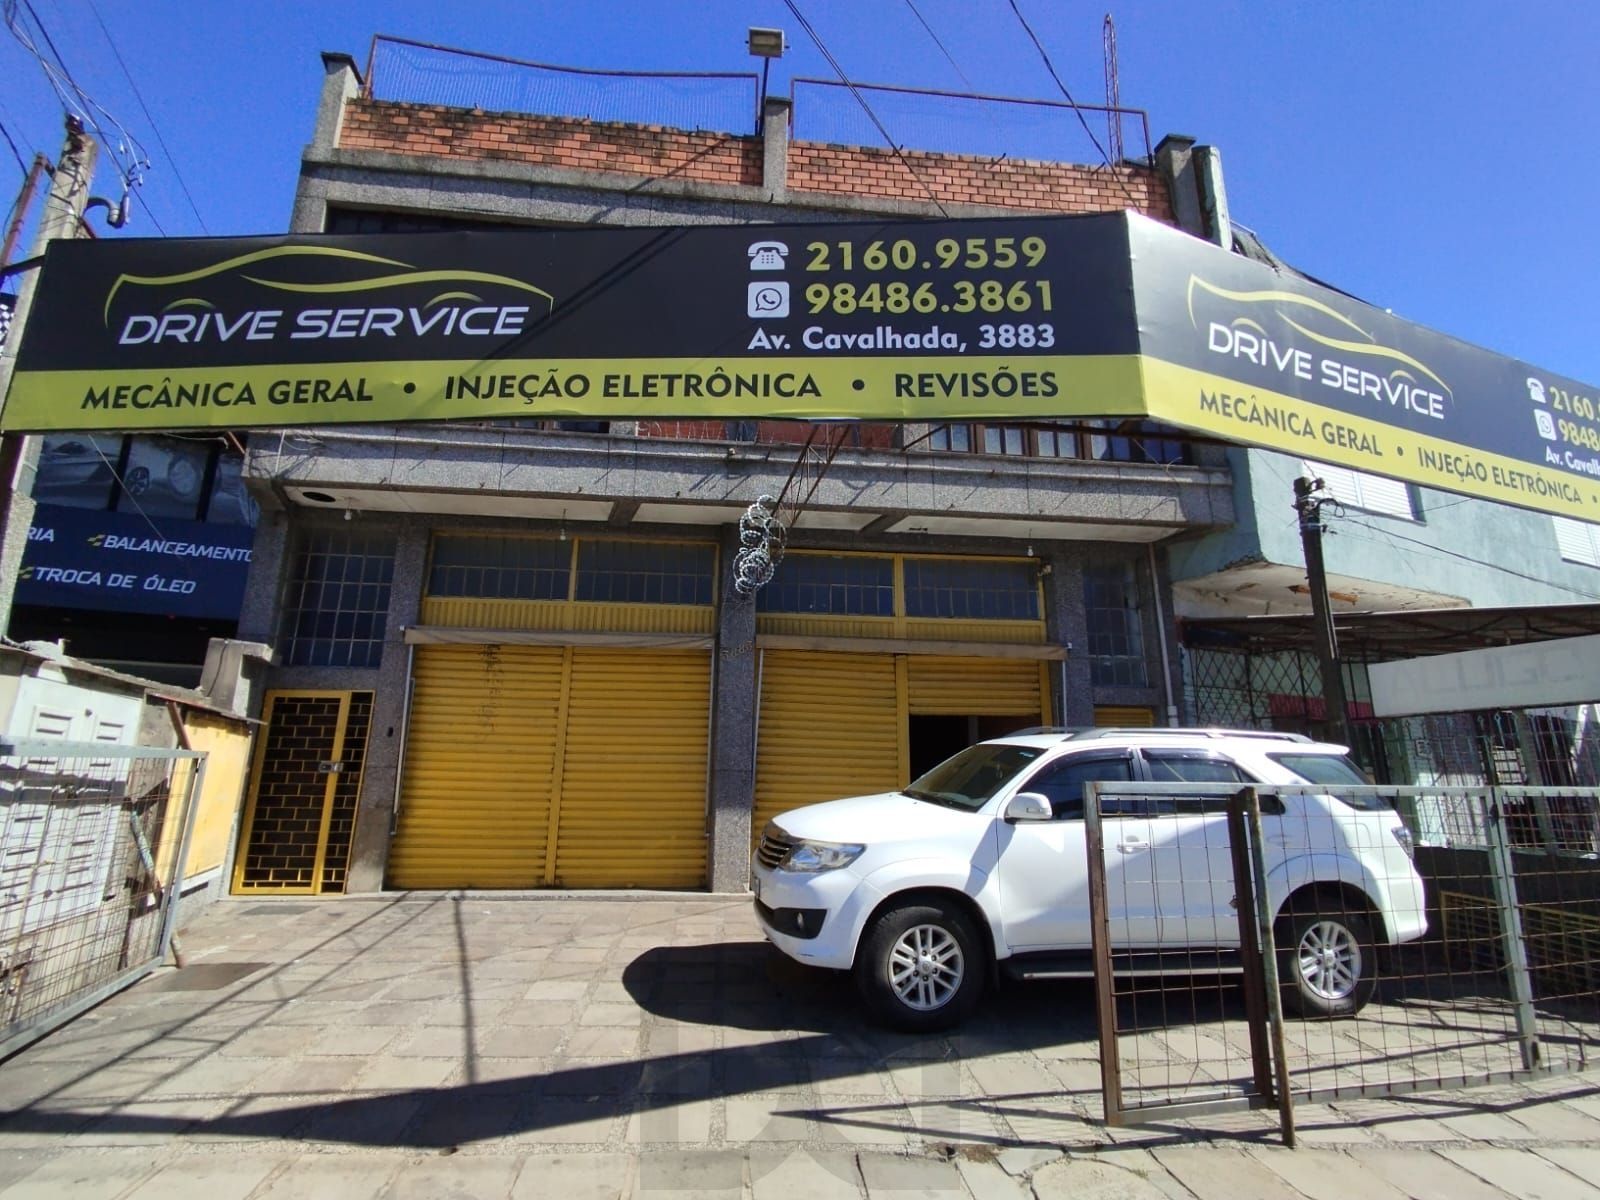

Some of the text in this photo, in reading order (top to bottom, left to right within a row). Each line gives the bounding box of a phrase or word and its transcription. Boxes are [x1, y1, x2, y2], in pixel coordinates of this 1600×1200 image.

[806, 237, 1048, 272] 2160.9559
[805, 280, 1053, 315] 98486.3861
[118, 306, 530, 345] DRIVE SERVICE
[747, 323, 1056, 352] Av. Cavalhada, 3883
[81, 366, 1059, 410] MECÂNICA GERAL INJEÇÃO ELETRÔNICA REVISÕES
[1208, 321, 1445, 420] DRIVE SERVICE
[1549, 386, 1600, 422] 2160.
[1200, 389, 1582, 504] MECÂNICA GERAL INJEÇÃO ELETRÔNICA
[1558, 418, 1600, 452] 9848
[1545, 446, 1564, 466] Av.
[36, 566, 197, 594] TROCA DE ÓLEO
